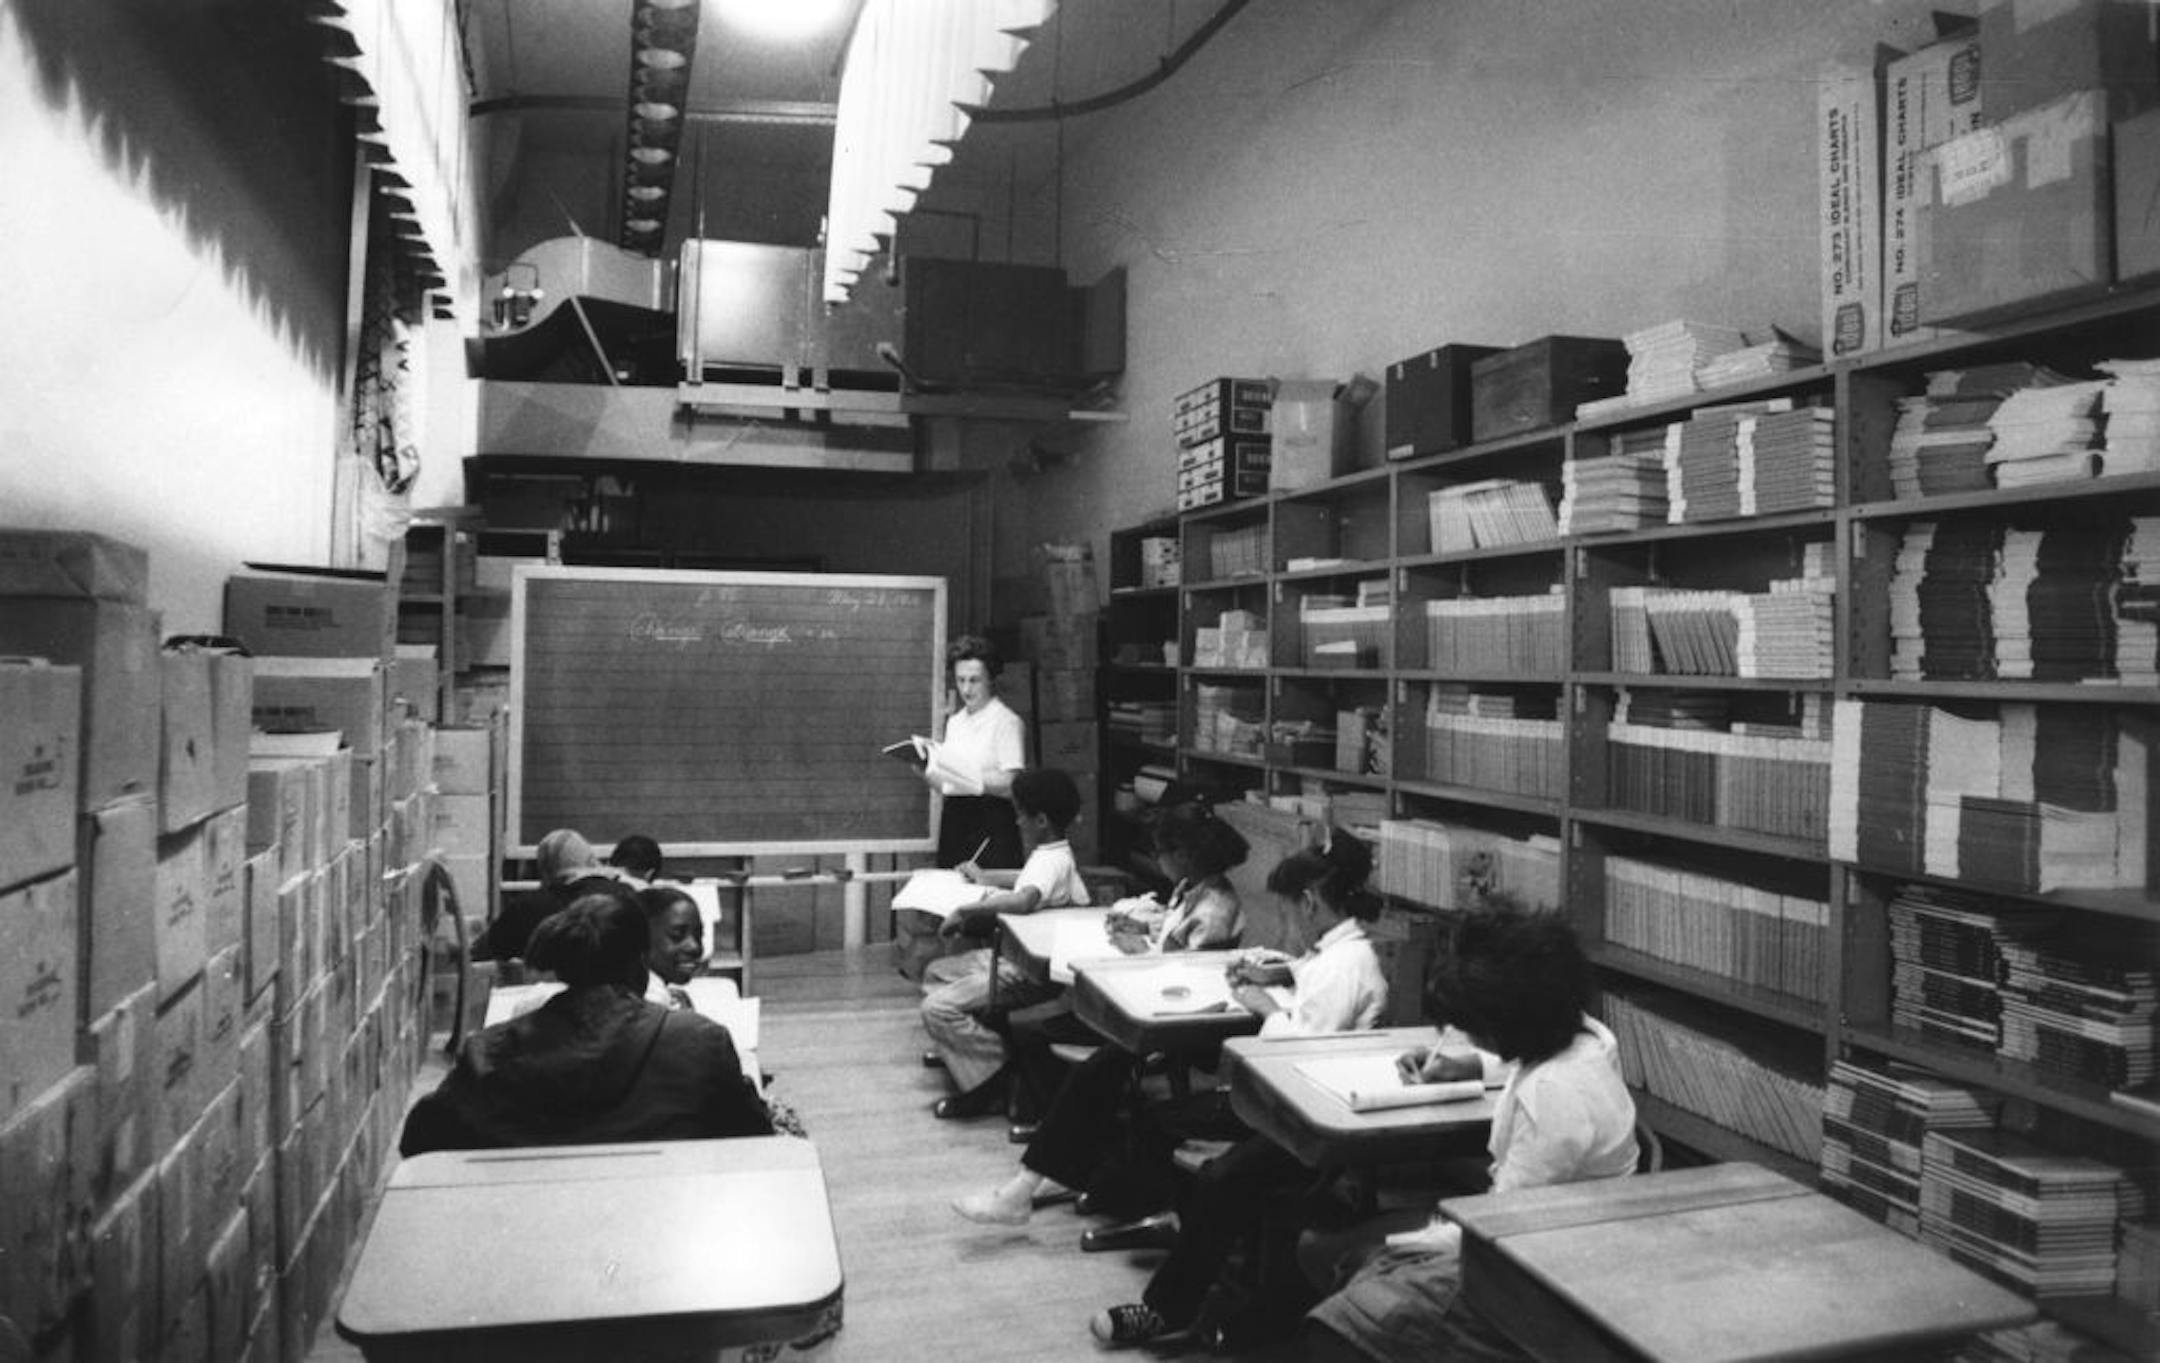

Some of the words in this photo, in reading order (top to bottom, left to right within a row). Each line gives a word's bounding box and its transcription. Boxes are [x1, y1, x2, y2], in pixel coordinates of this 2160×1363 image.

[1897, 77, 1907, 146] CHARTS
[1828, 107, 1841, 173] CHARTS
[1896, 150, 1905, 200] IDEAL
[1830, 177, 1842, 226] IDEAL
[1832, 232, 1842, 262] 273
